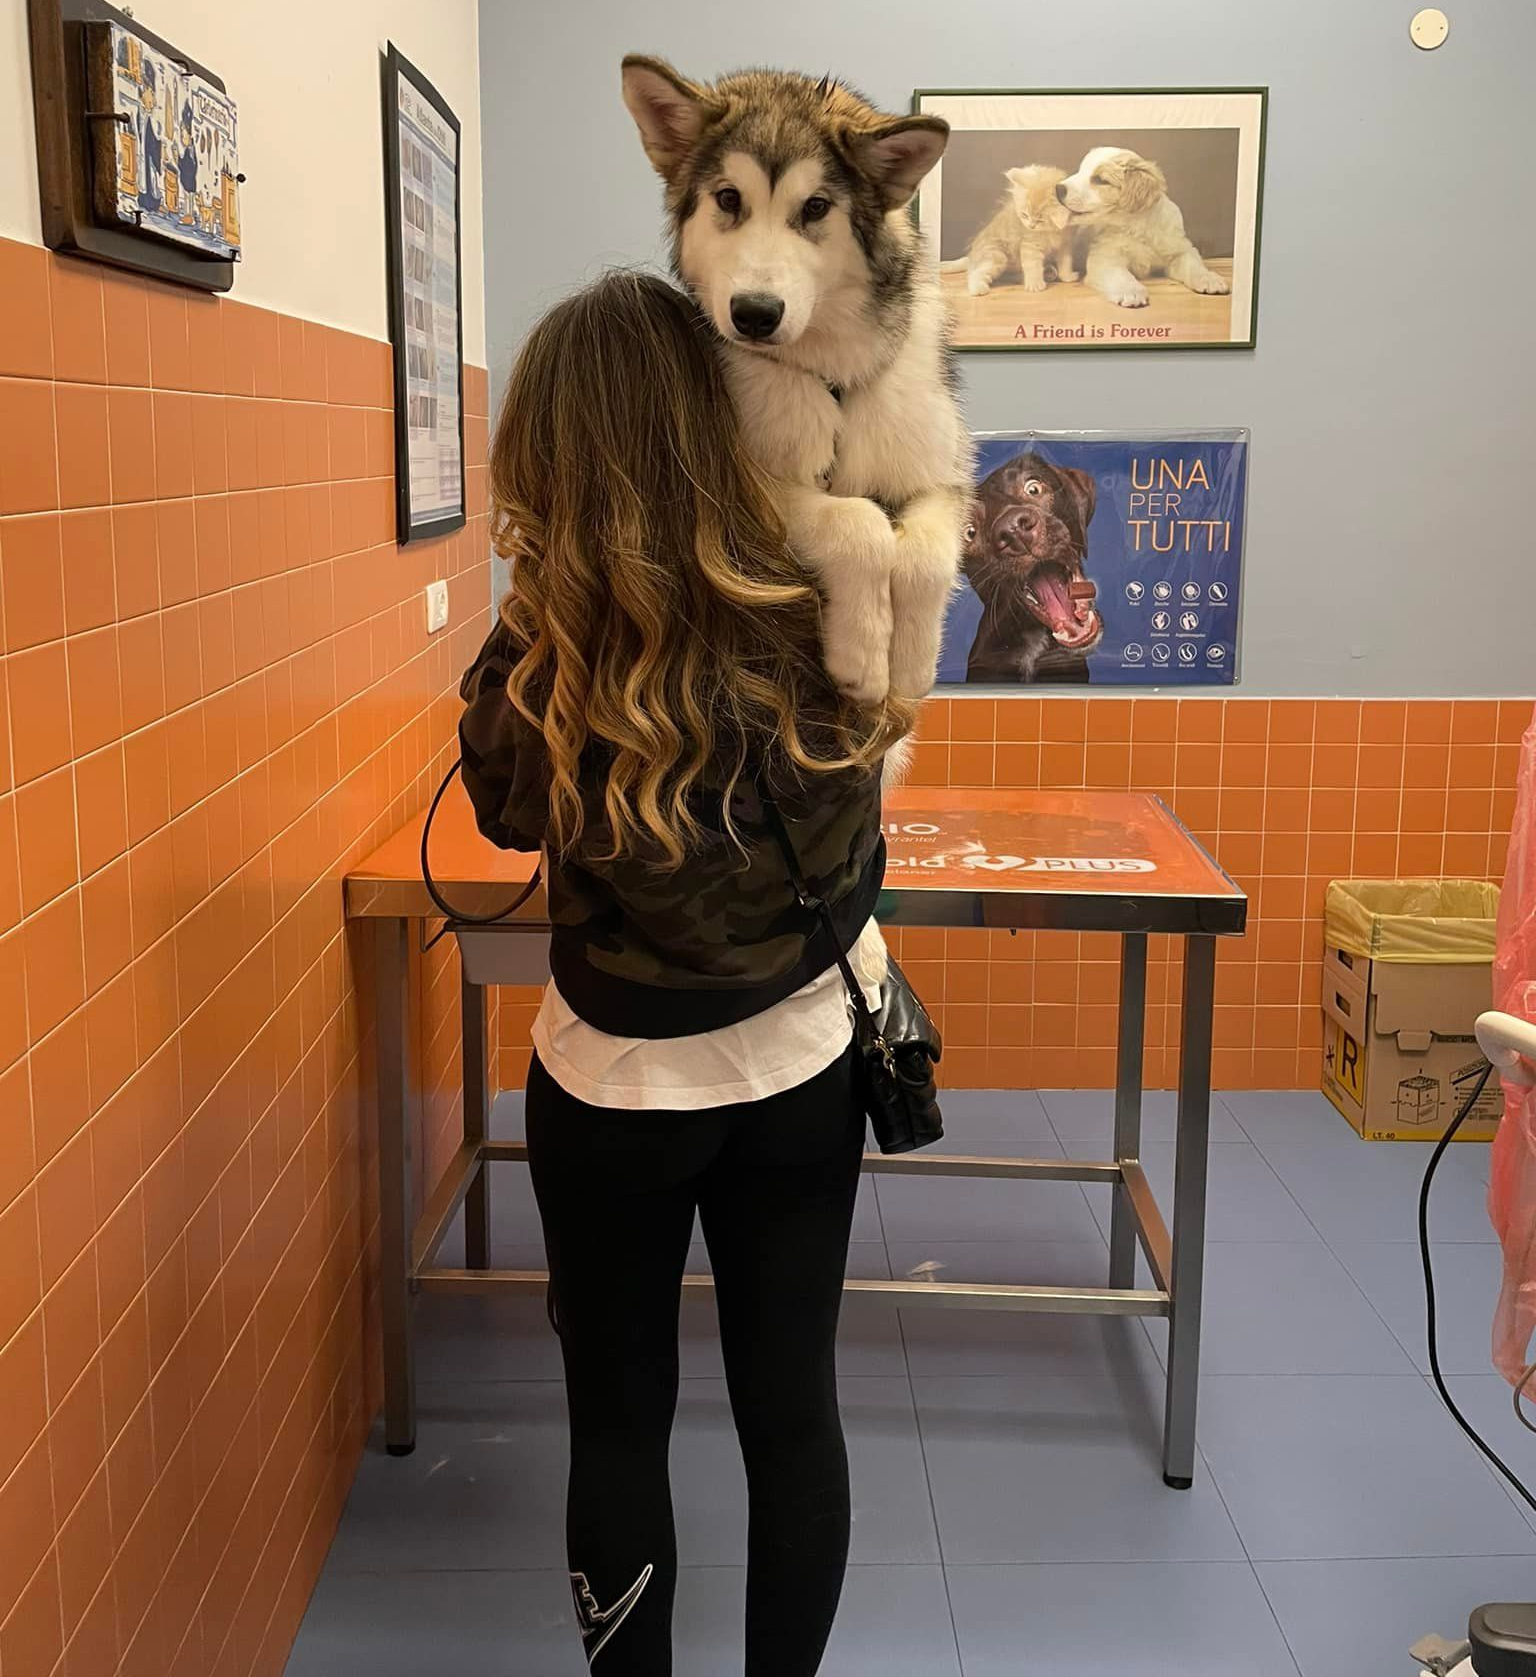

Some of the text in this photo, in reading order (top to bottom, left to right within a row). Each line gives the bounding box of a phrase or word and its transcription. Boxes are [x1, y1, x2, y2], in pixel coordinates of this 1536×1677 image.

[1014, 323, 1172, 339] A Friend is Forever
[1131, 458, 1210, 490] UNA
[1128, 493, 1182, 517] PER
[1127, 520, 1231, 551] TUTTI
[881, 823, 941, 835] IO
[1044, 859, 1142, 871] PLUS
[1342, 1031, 1358, 1090] R
